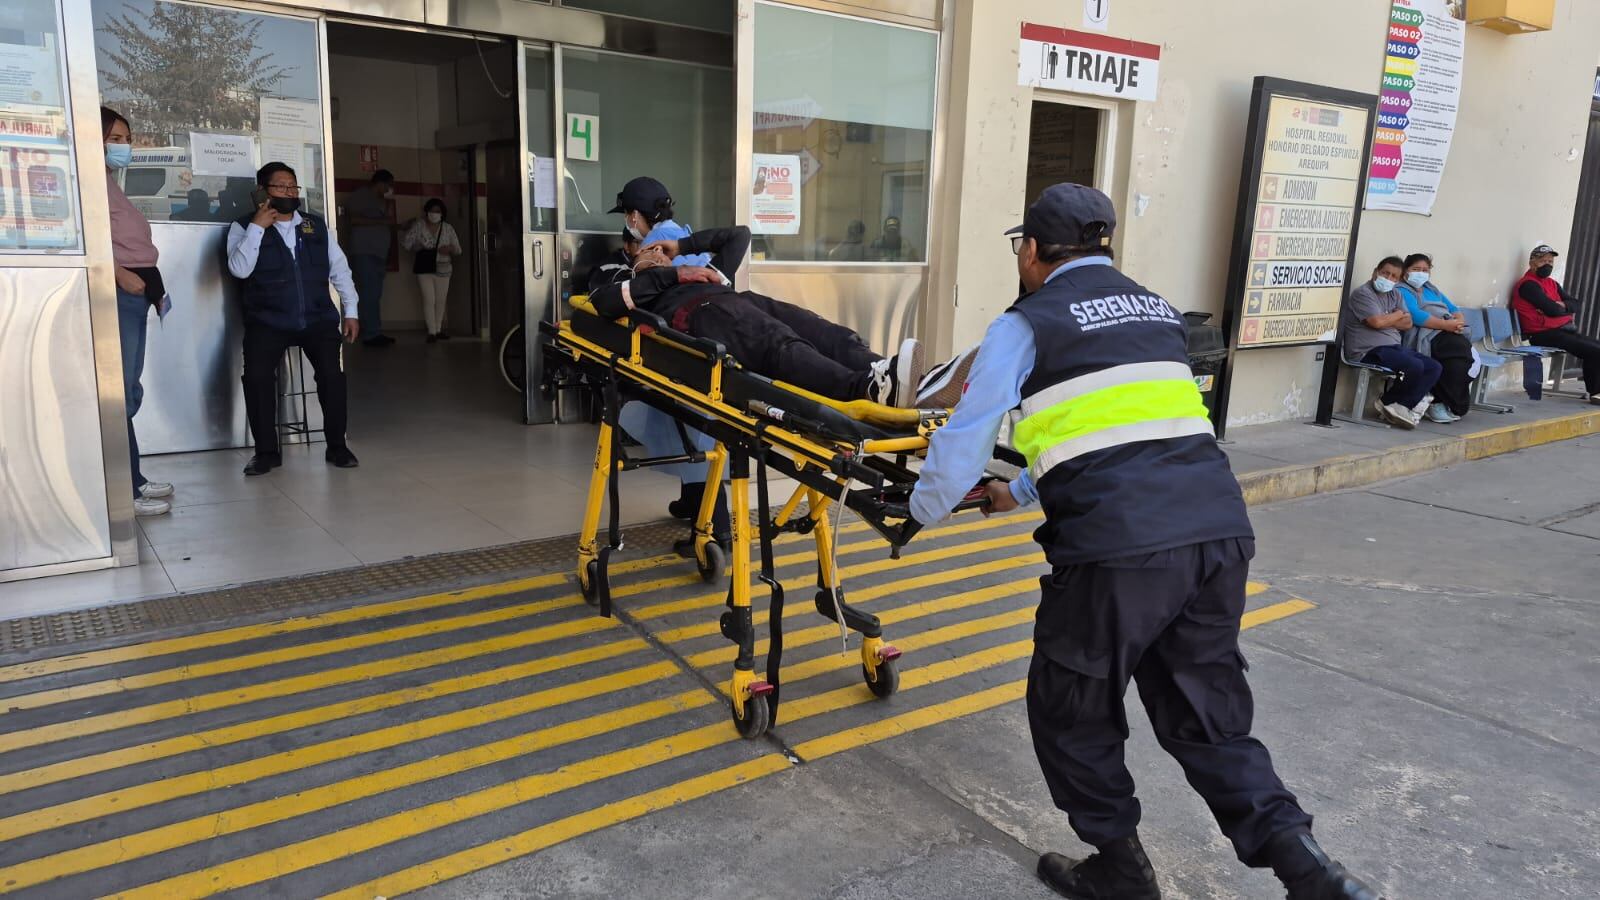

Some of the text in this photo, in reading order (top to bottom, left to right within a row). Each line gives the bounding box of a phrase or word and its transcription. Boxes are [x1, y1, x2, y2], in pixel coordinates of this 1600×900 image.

[1093, 0, 1101, 18] 1
[1392, 10, 1410, 21] PASO
[1412, 14, 1422, 23] 01
[1389, 27, 1420, 39] PASO 02
[1387, 43, 1407, 53] PASO
[1408, 47, 1418, 56] 03
[1066, 49, 1139, 93] TRIAJE
[1383, 76, 1402, 86] PASO
[1404, 80, 1413, 88] 05
[1380, 96, 1399, 106] PASO
[1401, 99, 1410, 108] 06
[1378, 115, 1398, 125] PASO
[1398, 118, 1407, 126] 07
[572, 117, 591, 158] 4
[1285, 127, 1348, 145] HOSPITAL REGIONAL
[1376, 131, 1394, 140] PASO
[1268, 141, 1359, 160] HONORIO DELGADO ESPINOZA
[1298, 158, 1329, 170] AREQUIPA
[1372, 156, 1390, 166] PASO
[1391, 159, 1400, 167] 09
[1282, 179, 1318, 200] ADMISION
[1279, 208, 1350, 230] EMERGENCIA ADULTOS
[1275, 237, 1314, 256] EMERGENCIA
[1272, 266, 1341, 284] SERVICIO SOCIAL
[1069, 294, 1175, 324] SERENAZGO
[1267, 292, 1302, 311] FARMACIA
